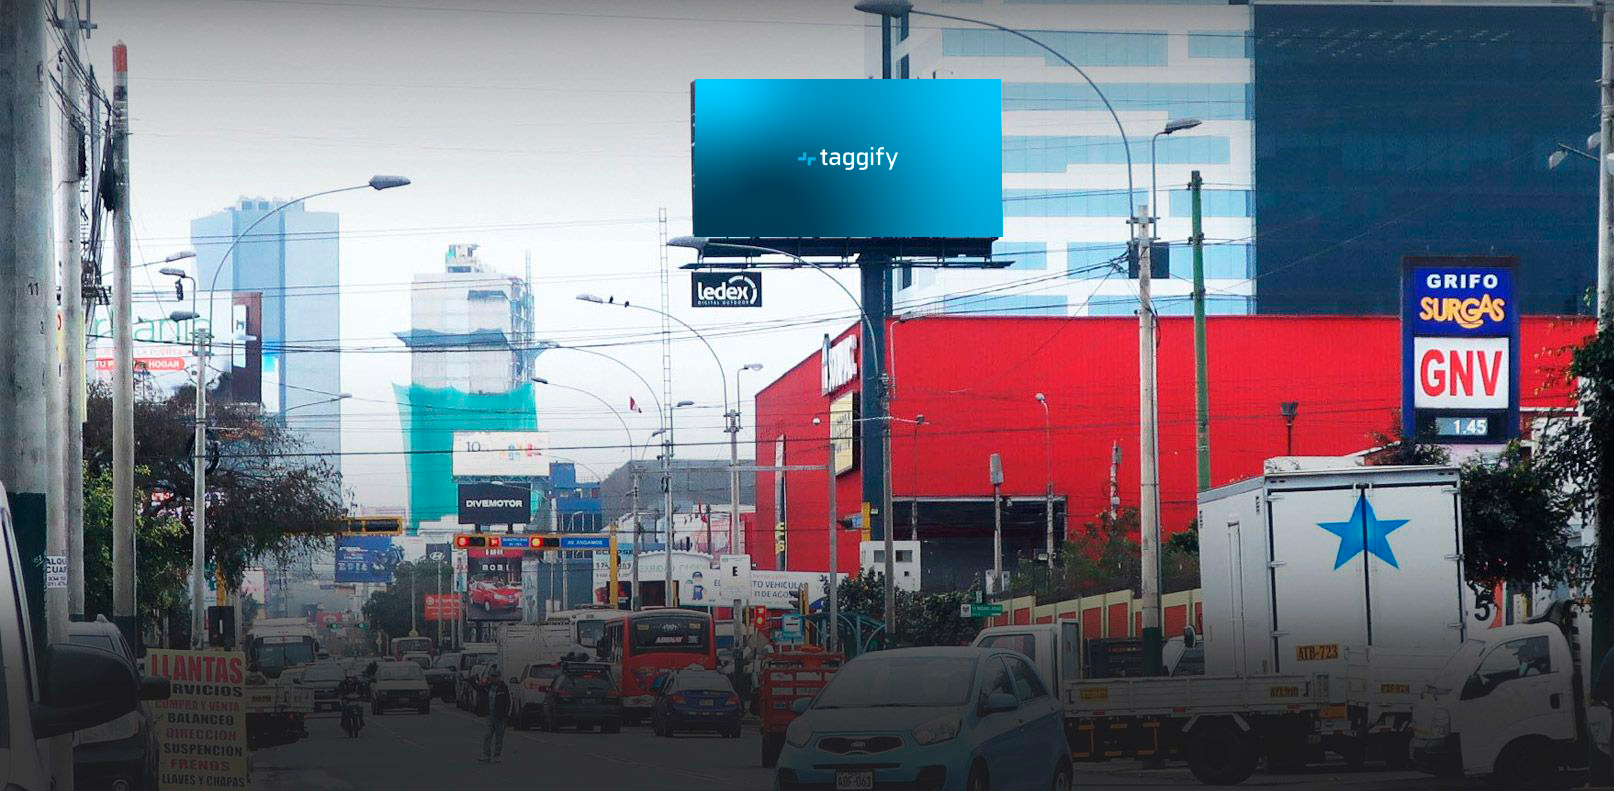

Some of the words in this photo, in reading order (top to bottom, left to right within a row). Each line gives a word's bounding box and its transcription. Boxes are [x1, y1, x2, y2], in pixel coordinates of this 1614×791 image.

[820, 146, 898, 171] taggify
[1426, 273, 1498, 290] GRIFO
[698, 281, 749, 301] ledex
[1420, 293, 1506, 329] SURGAS
[148, 360, 180, 368] HOGAR
[1420, 349, 1503, 397] GNV
[1453, 418, 1487, 434] 1.45
[466, 499, 522, 508] DIVEMOTOR
[733, 566, 740, 577] E
[168, 713, 234, 726] BALANCEO
[170, 759, 231, 771] FRENOS
[162, 774, 196, 784] LLAVES
